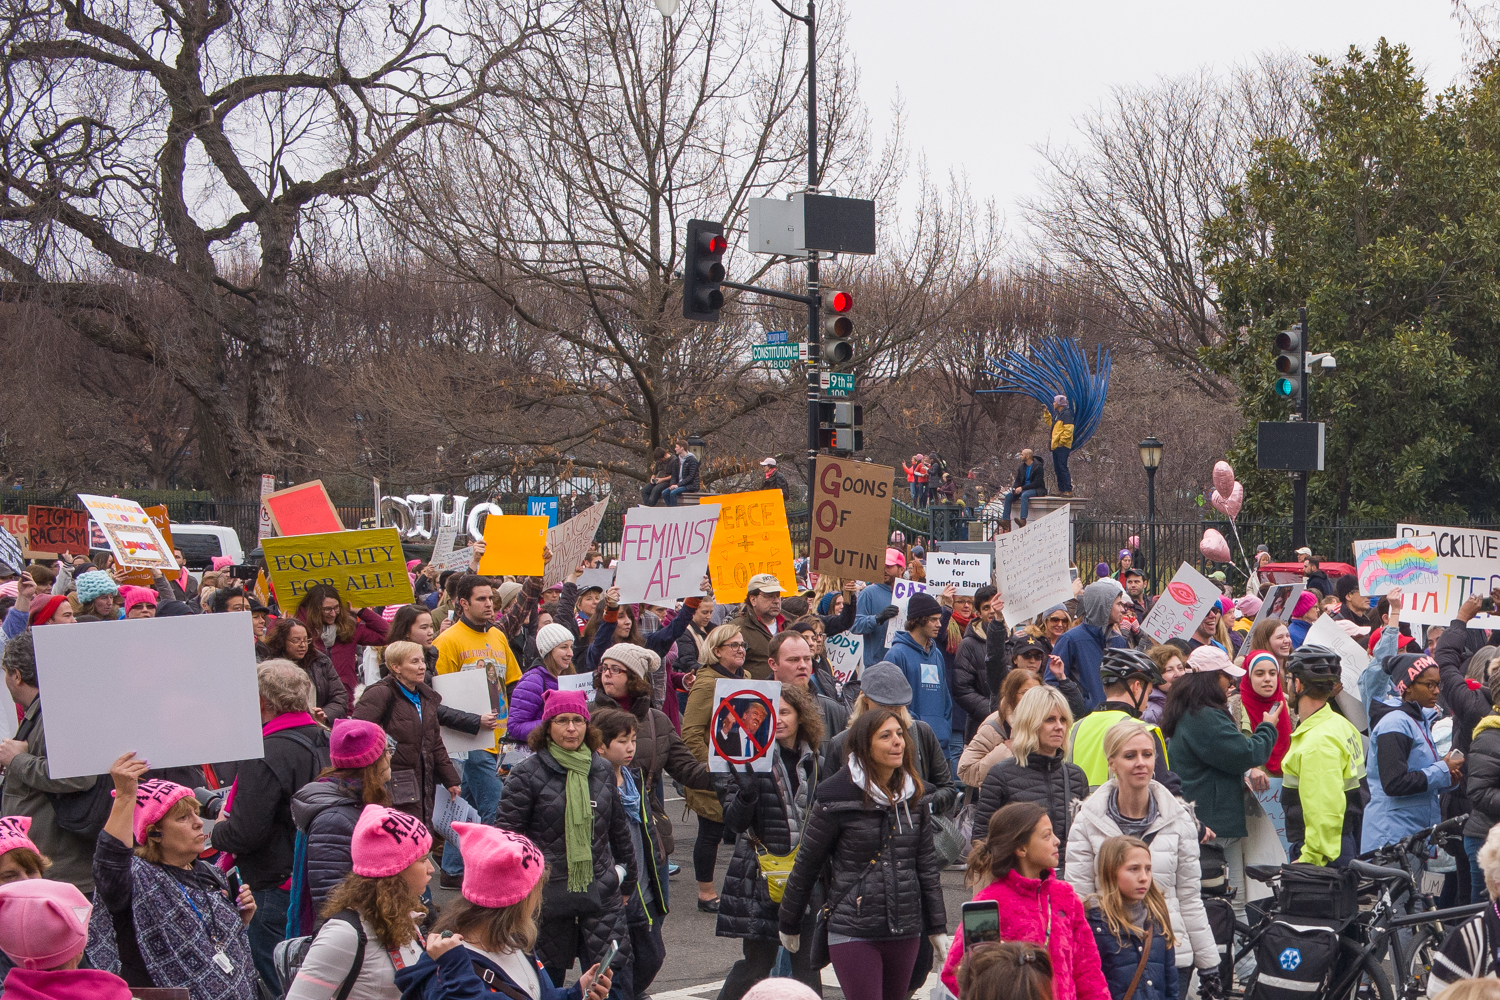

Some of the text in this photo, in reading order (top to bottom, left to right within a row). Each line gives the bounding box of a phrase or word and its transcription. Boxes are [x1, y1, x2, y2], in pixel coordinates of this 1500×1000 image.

[753, 346, 792, 359] CONSTITUTION
[773, 360, 789, 368] 800
[831, 375, 845, 387] 9th
[820, 463, 887, 498] GOONS
[35, 508, 84, 526] FIGHT
[531, 502, 546, 515] WE
[717, 503, 775, 530] EACE
[816, 500, 852, 532] OF
[549, 502, 605, 550] LACK
[29, 527, 87, 546] RACISM
[621, 518, 718, 561] FEMINIST
[813, 537, 878, 570] PUTIN
[1360, 540, 1390, 556] KEEP
[274, 545, 395, 572] EQUALITY
[937, 557, 980, 566] We March
[1366, 557, 1432, 571] TINY HANDS
[345, 572, 395, 592] ALL!
[644, 556, 687, 600] AF
[951, 569, 965, 577] for
[1362, 571, 1439, 588] OFF OUR RIGHTS
[962, 580, 988, 589] Bland
[1145, 603, 1167, 630] THIS
[1183, 593, 1207, 622] BACK
[1154, 610, 1178, 639] PUSSY
